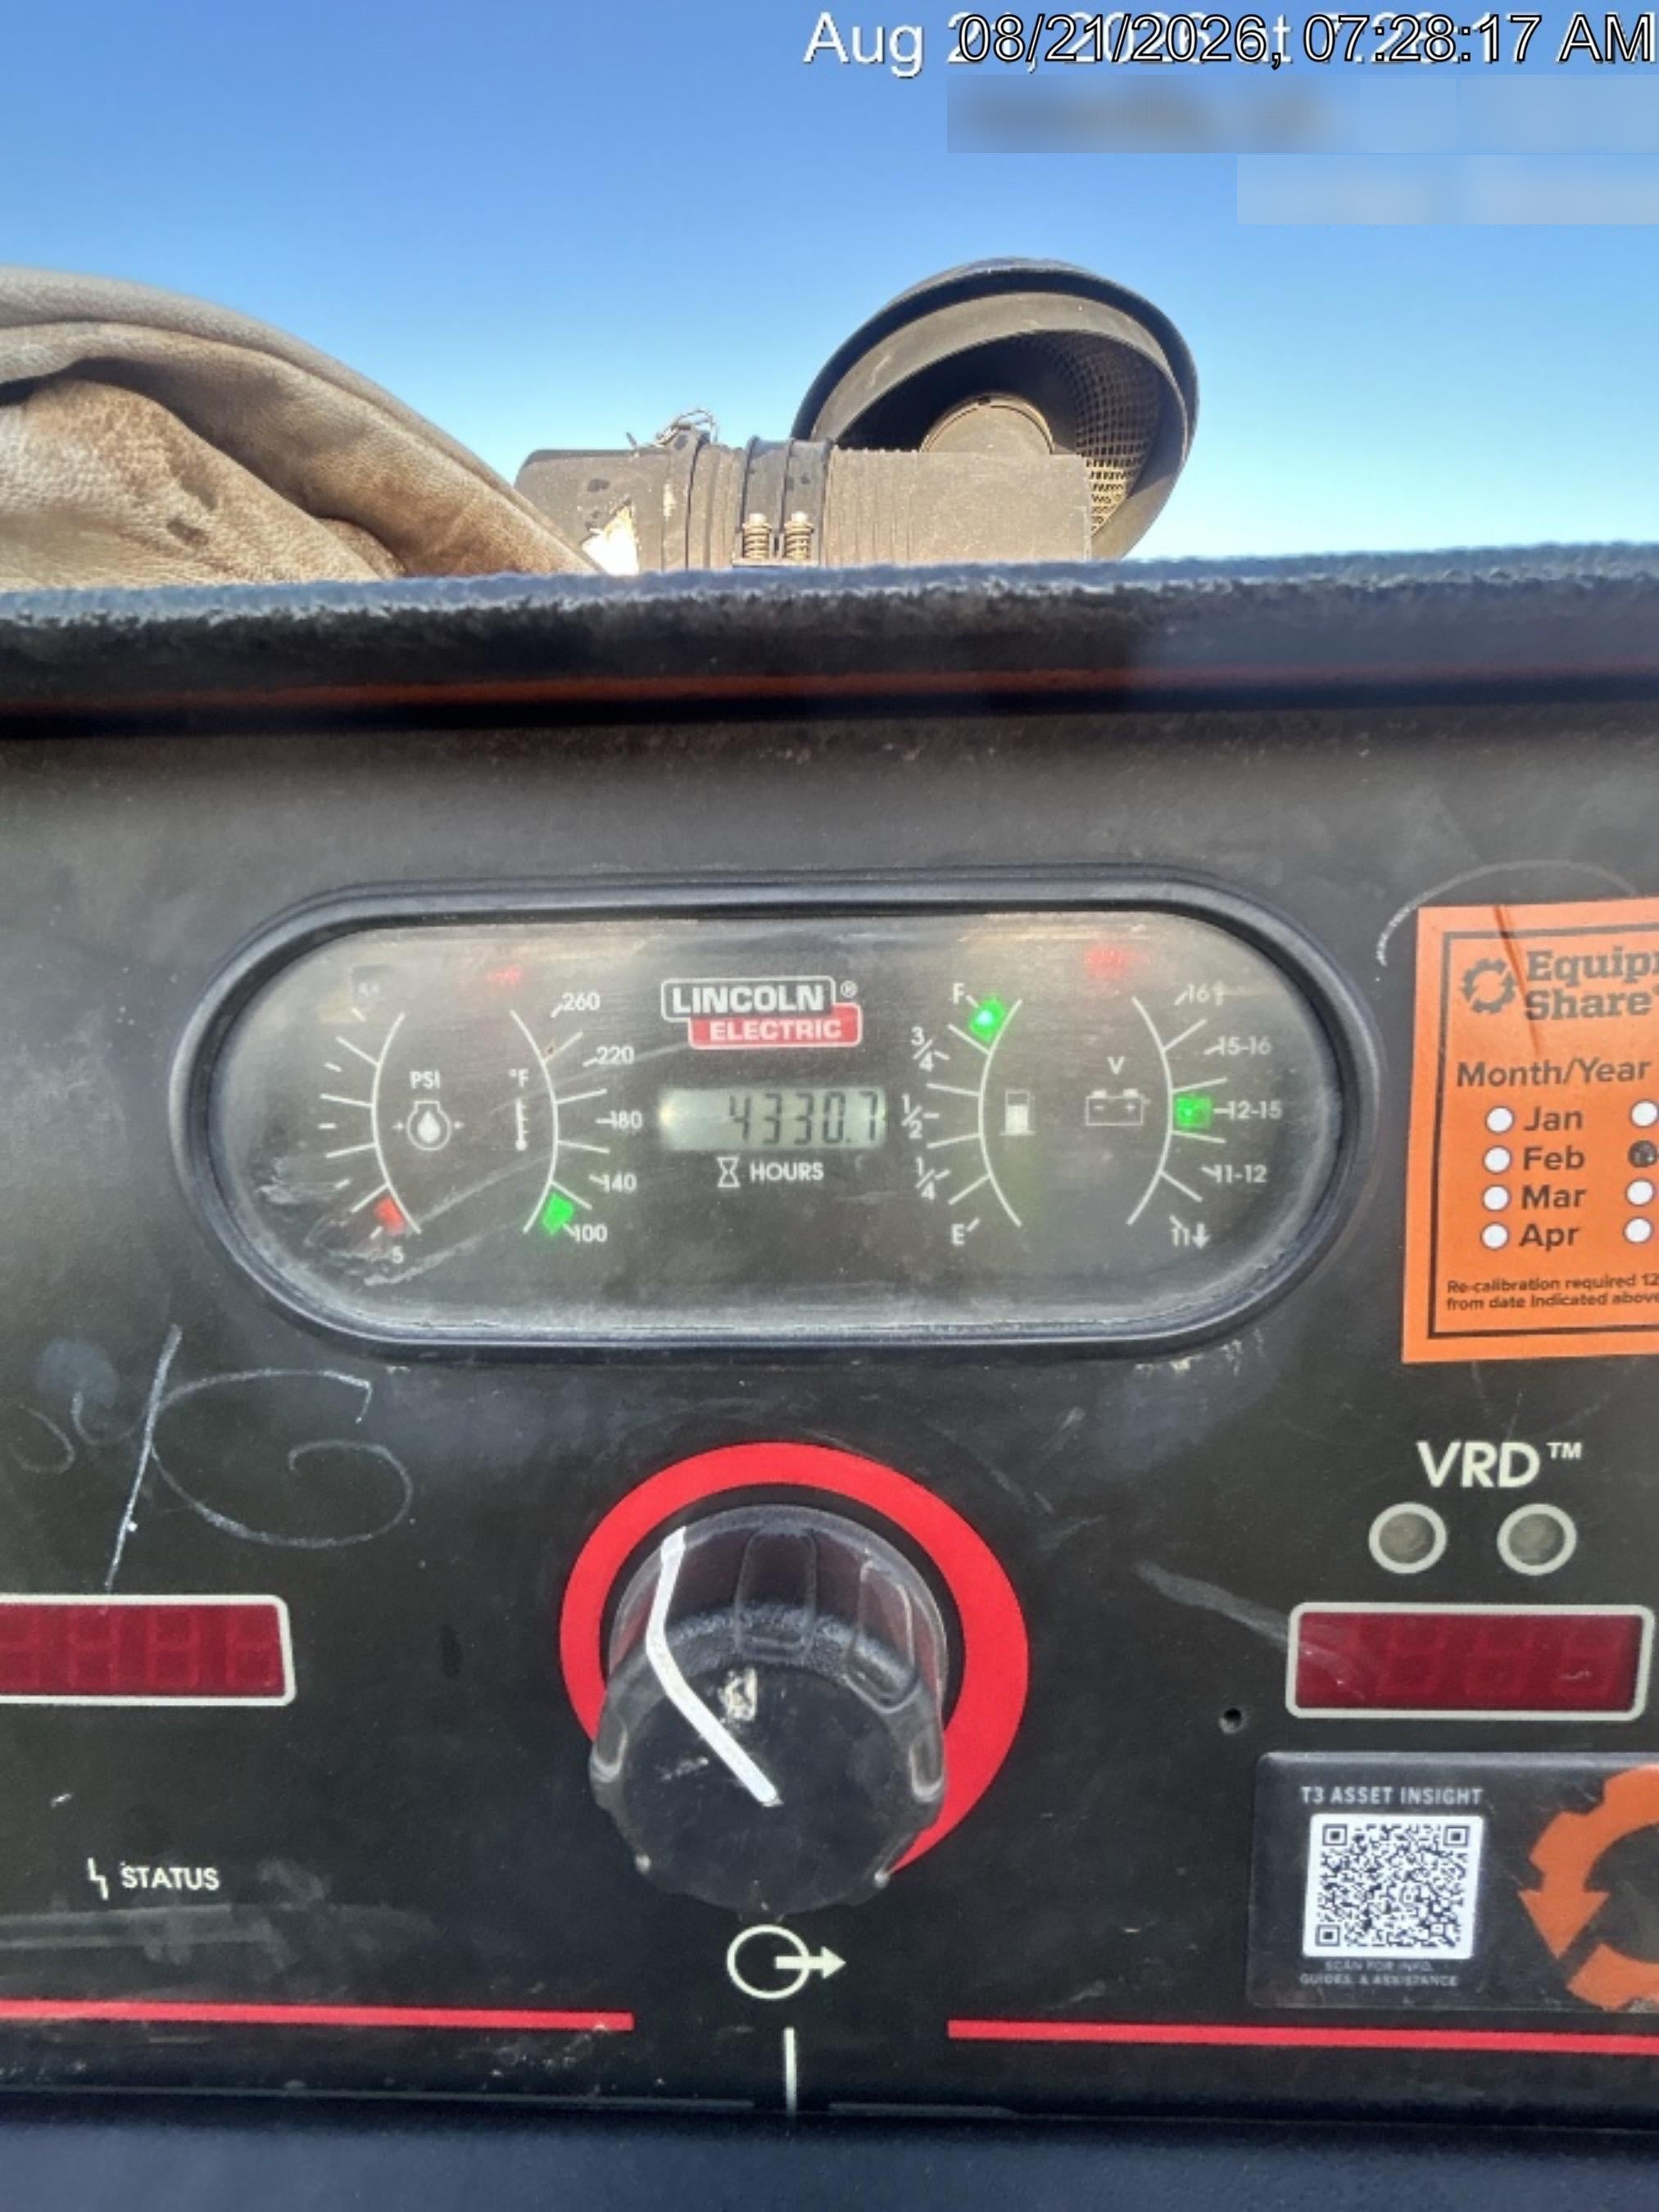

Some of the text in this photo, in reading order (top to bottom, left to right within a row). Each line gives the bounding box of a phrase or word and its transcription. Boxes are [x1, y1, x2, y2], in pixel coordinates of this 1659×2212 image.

[562, 992, 601, 1010] 260
[673, 985, 824, 1013] LINCOLN
[953, 982, 965, 1004] F
[709, 1019, 841, 1041] ELECTRIC
[596, 1046, 635, 1064] 220
[1217, 1036, 1271, 1055] 15-16
[1107, 1056, 1126, 1075] V
[1457, 1056, 1652, 1087] Month/Year
[410, 1070, 441, 1090] PSI
[610, 1111, 643, 1129] 180
[1227, 1100, 1282, 1120] 12-15
[1524, 1107, 1583, 1131] Jan
[1523, 1145, 1585, 1171] Feb
[749, 1162, 824, 1181] HOURS
[1213, 1164, 1267, 1183] 11-12
[602, 1174, 637, 1193] 140
[1521, 1184, 1586, 1209] Mar
[574, 1224, 607, 1243] 100
[950, 1224, 965, 1246] E
[1519, 1223, 1580, 1252] Apr
[1447, 1278, 1561, 1294] Re-calibration
[1566, 1274, 1636, 1291] required
[1447, 1297, 1485, 1312] from
[1489, 1295, 1525, 1309] date
[1301, 1786, 1484, 1805] T3 ASSET INSIGHT
[120, 1865, 220, 1891] STATUS
